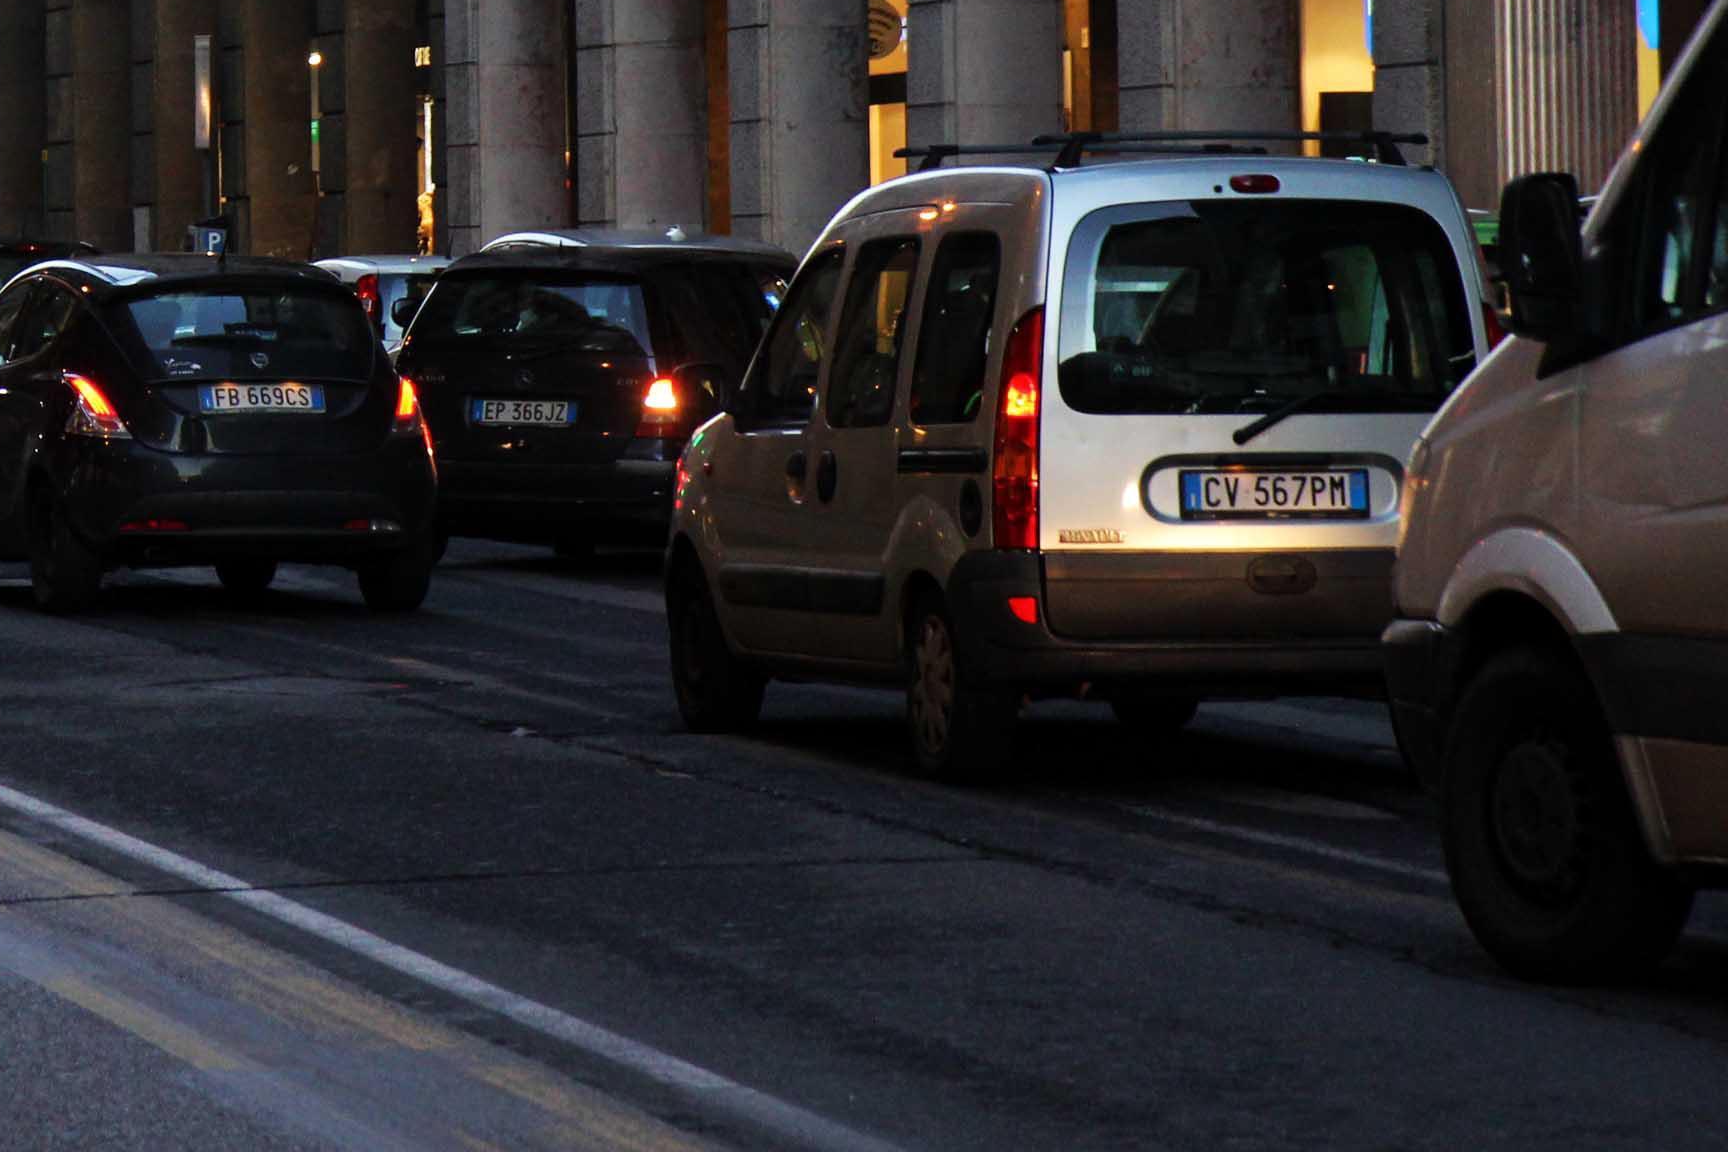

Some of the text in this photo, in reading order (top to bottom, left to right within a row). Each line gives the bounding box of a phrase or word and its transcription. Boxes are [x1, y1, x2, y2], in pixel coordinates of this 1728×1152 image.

[209, 232, 221, 251] P
[215, 387, 311, 406] FB 669CS
[484, 403, 567, 422] EP 366JZ
[1205, 477, 1239, 508] CV
[1254, 476, 1346, 508] 567PM
